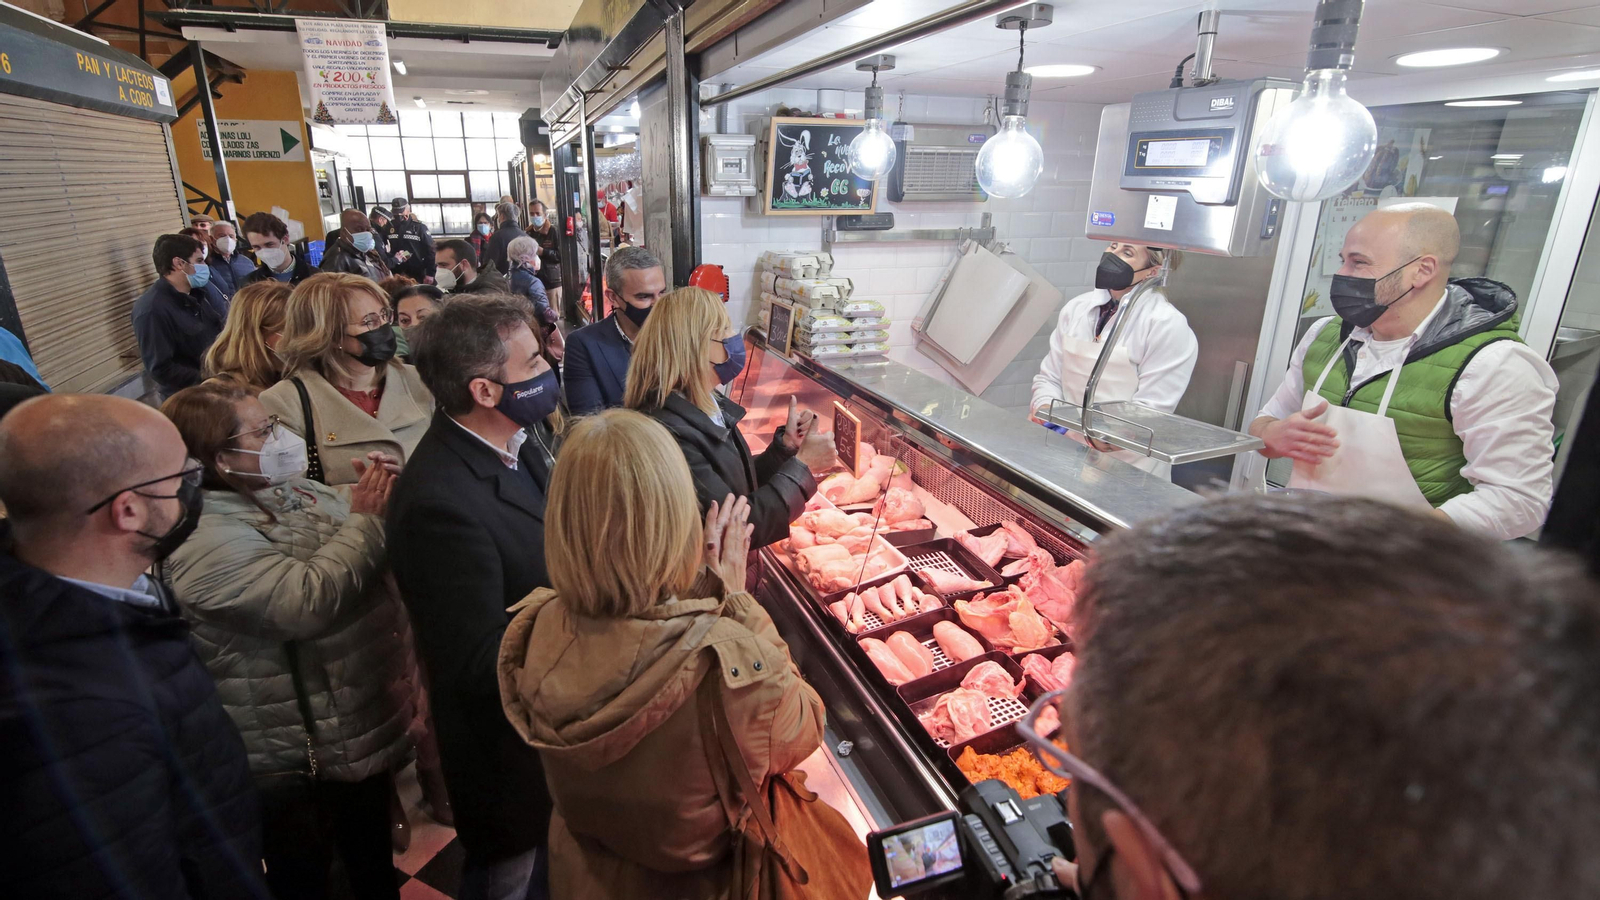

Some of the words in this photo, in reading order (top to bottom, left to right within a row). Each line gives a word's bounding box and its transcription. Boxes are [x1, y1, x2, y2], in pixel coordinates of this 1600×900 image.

[0, 52, 12, 74] 6
[76, 52, 100, 76] PAN
[103, 62, 111, 78] Y
[114, 65, 154, 91] LACTEOS
[333, 72, 365, 82] 200€
[129, 88, 153, 108] COBO
[1210, 97, 1234, 107] DIBAL
[828, 133, 841, 146] La
[1337, 196, 1375, 206] febrero
[517, 385, 543, 399] populares
